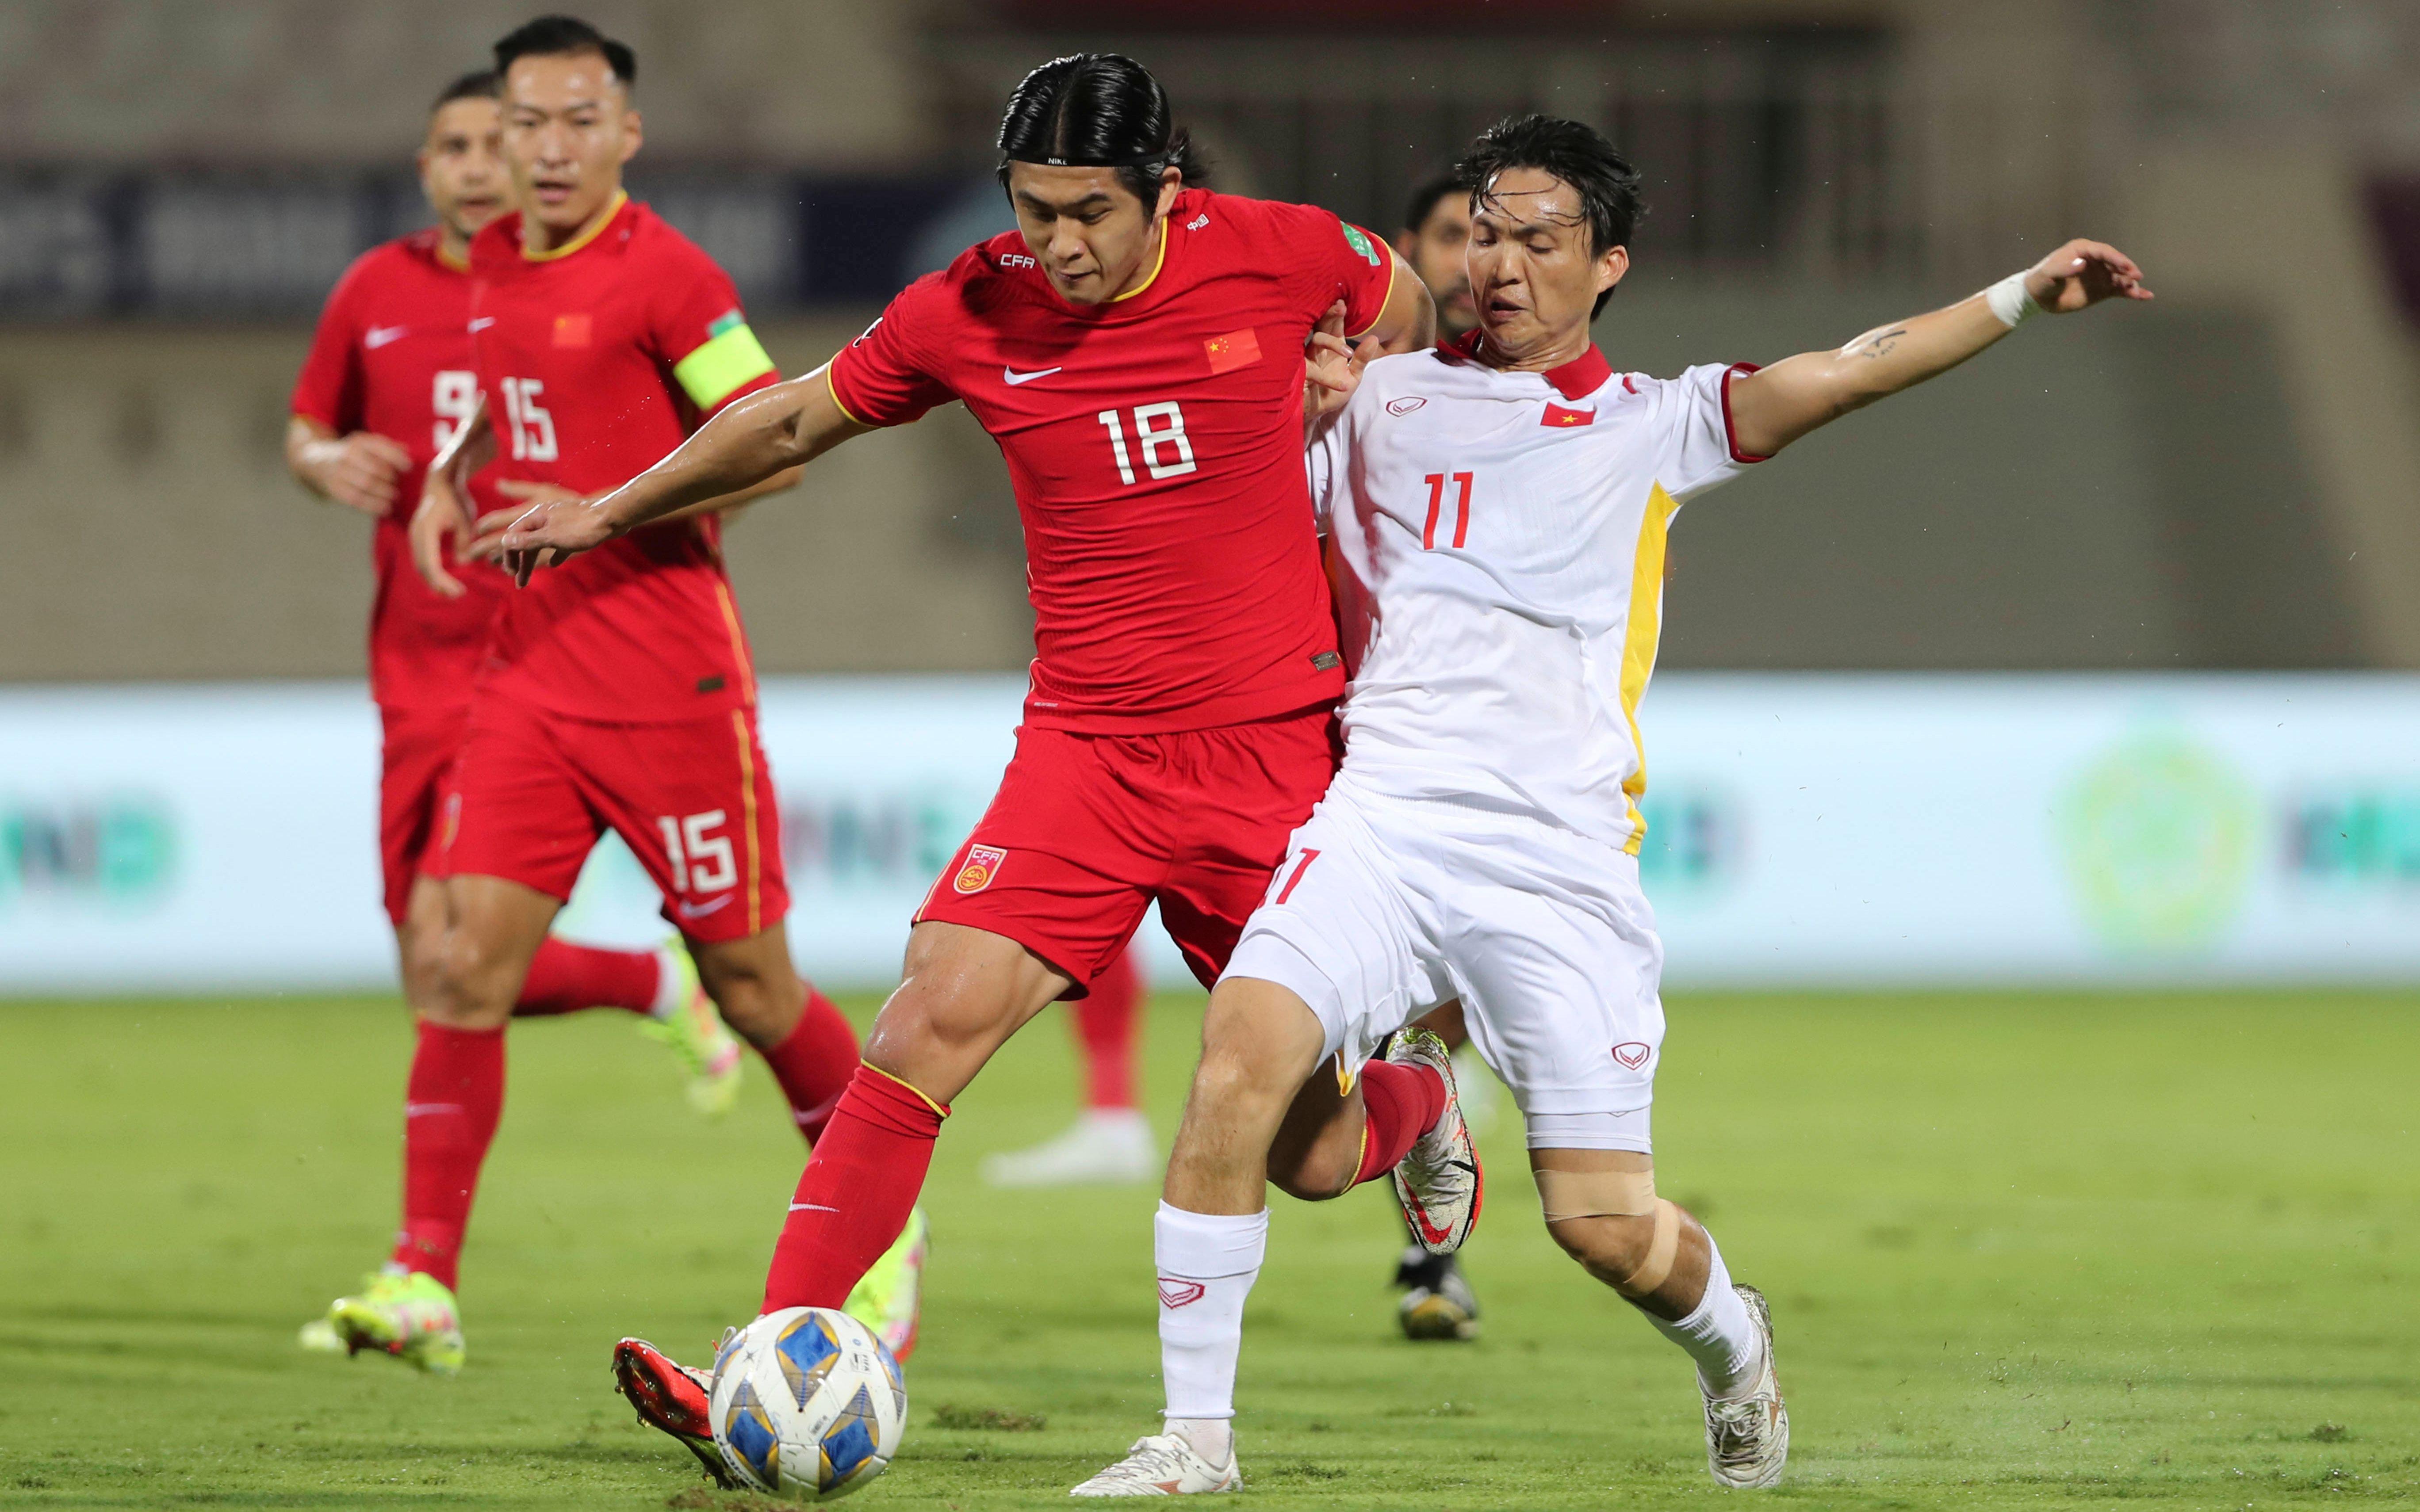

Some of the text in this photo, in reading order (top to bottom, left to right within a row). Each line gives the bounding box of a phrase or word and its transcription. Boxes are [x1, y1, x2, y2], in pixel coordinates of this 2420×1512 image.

[1000, 253, 1035, 269] CFA
[501, 376, 559, 462] 15
[1099, 401, 1197, 485] 18
[1424, 471, 1474, 550] 11
[657, 809, 738, 892] 15
[972, 849, 1000, 862] CFA
